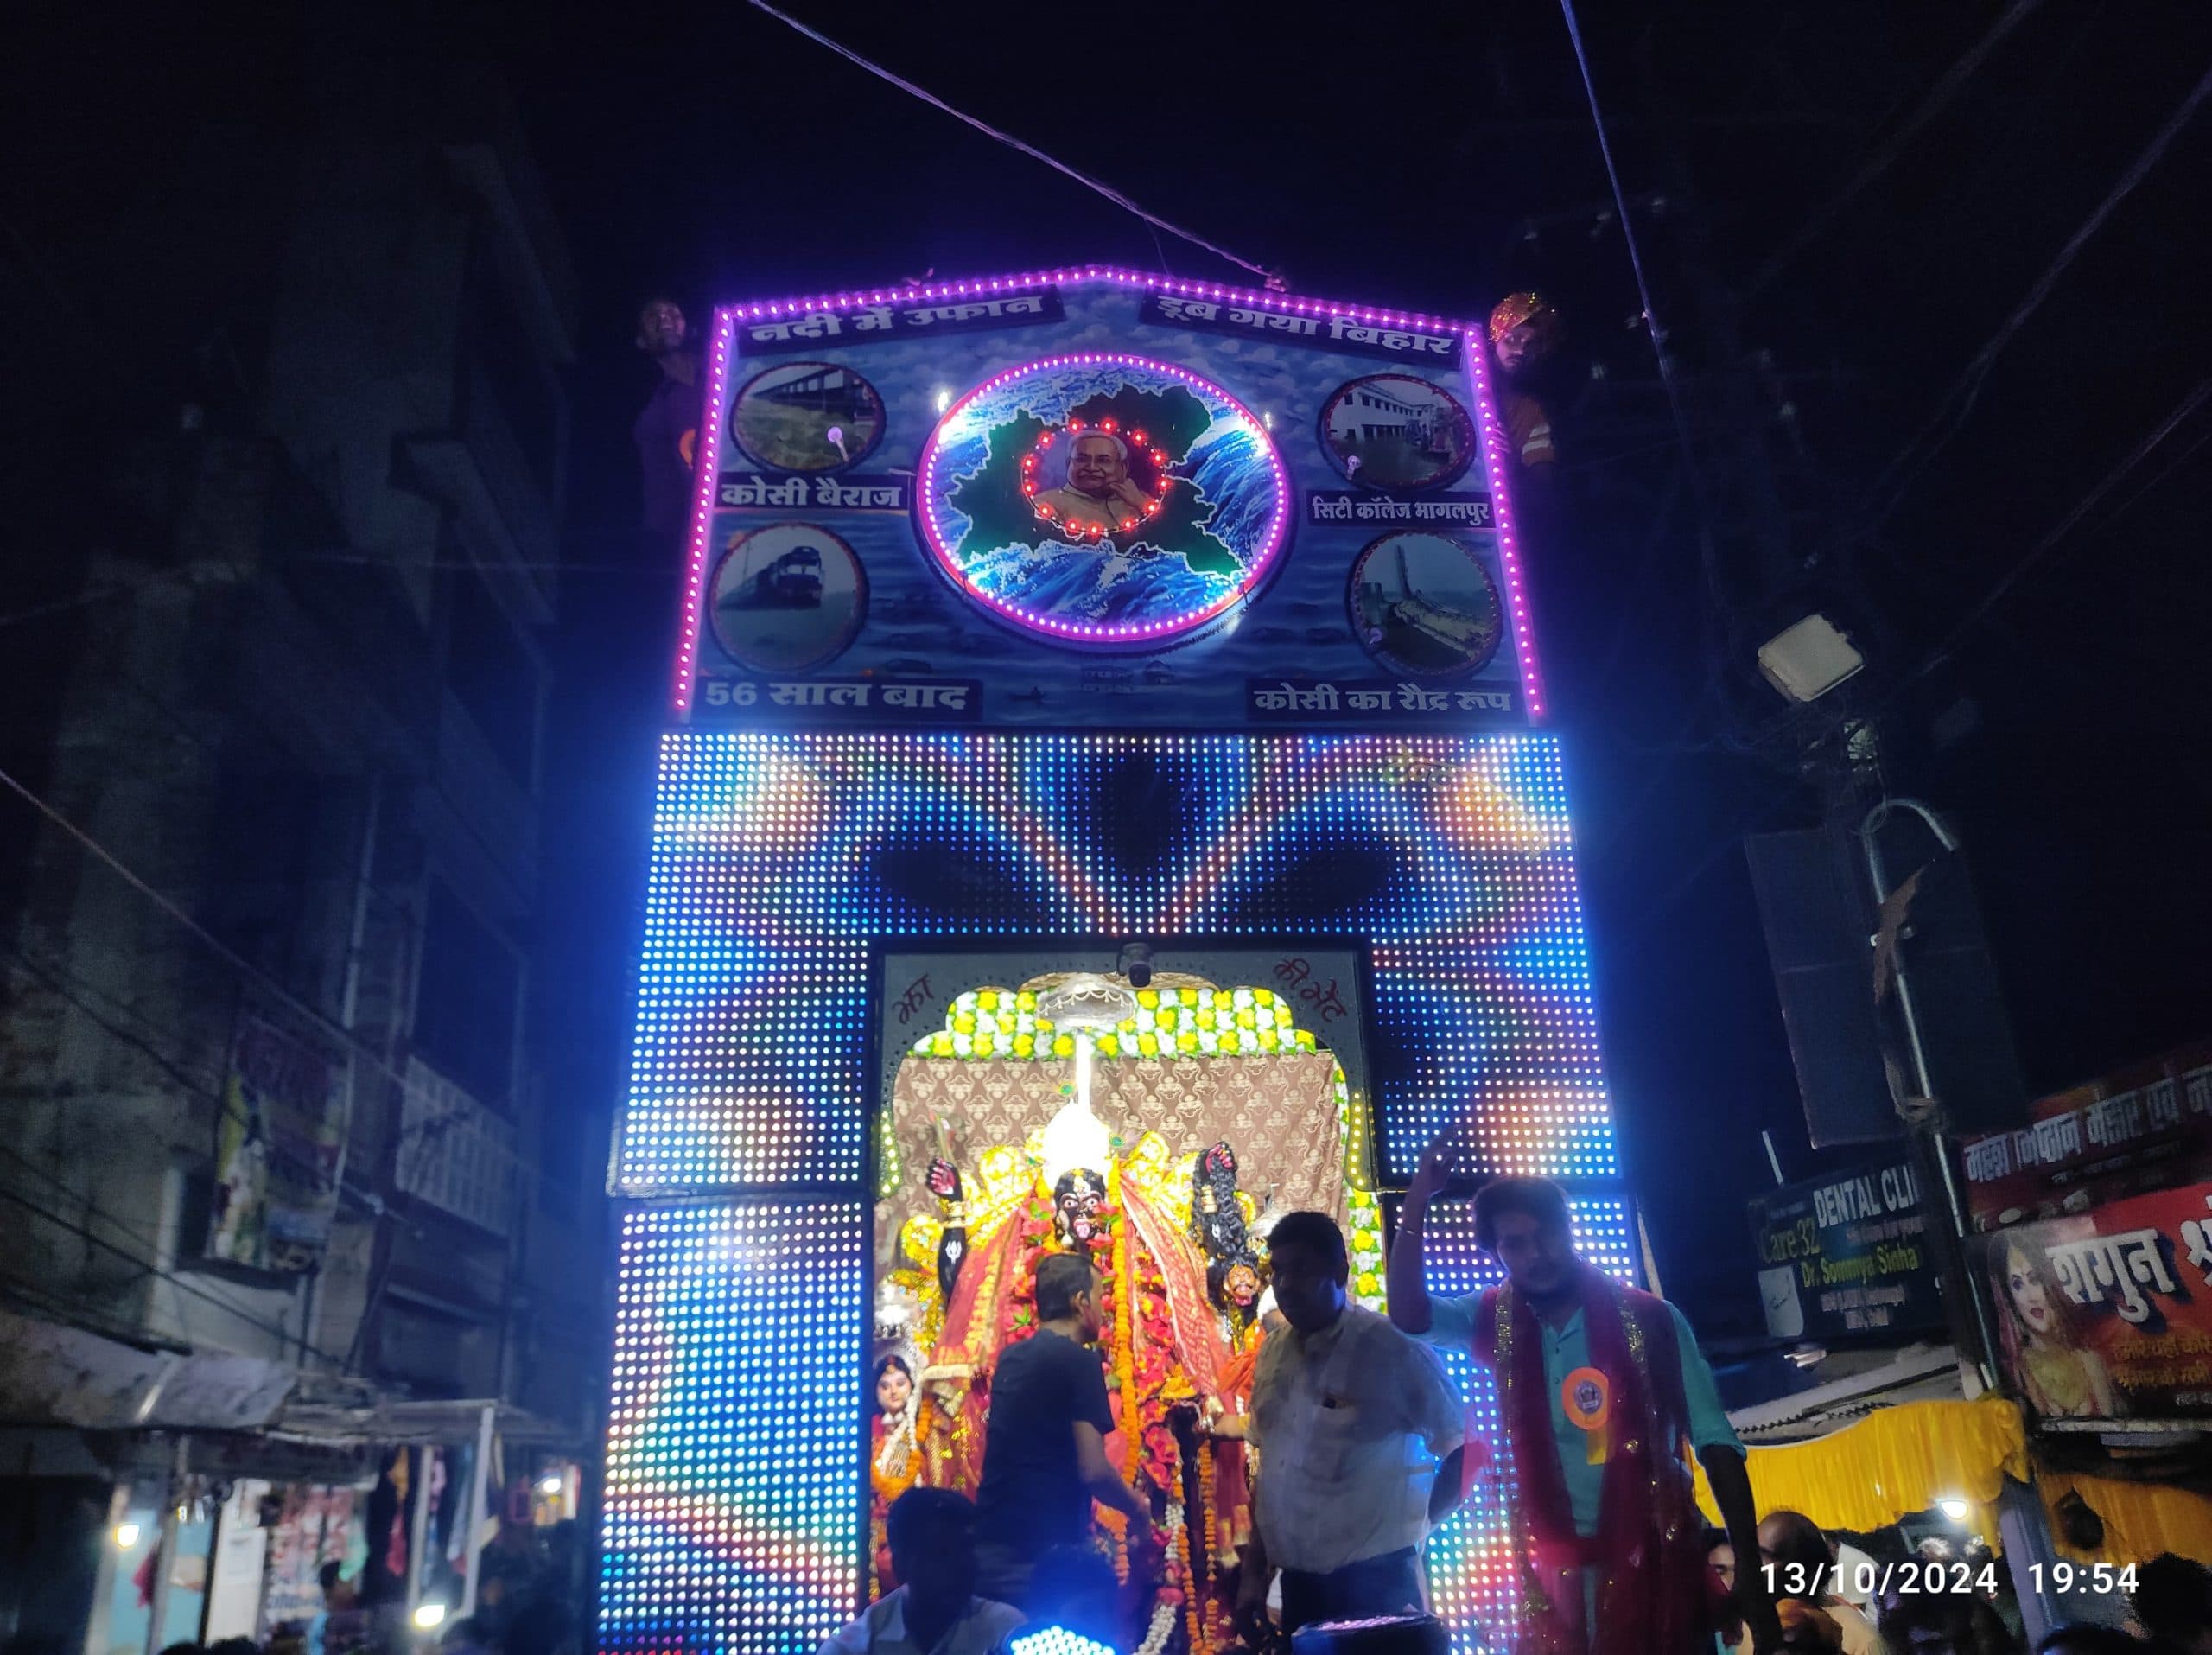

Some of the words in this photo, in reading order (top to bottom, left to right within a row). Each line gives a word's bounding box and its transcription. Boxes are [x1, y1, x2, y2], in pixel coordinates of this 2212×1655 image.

[748, 312, 843, 342] नदी
[851, 305, 898, 334] में
[903, 294, 1044, 327] उफान
[1158, 295, 1222, 323] डूब
[1229, 308, 1320, 338] गया
[1328, 315, 1455, 356] बिहार
[721, 475, 810, 506] कोसी
[815, 476, 903, 506] बैराज
[1313, 496, 1353, 519] सिटी
[1356, 495, 1412, 519] कॉलेज
[1414, 501, 1490, 526] भागलपुर
[705, 682, 757, 706] 56
[769, 682, 872, 708] साल
[880, 684, 970, 710] बाद
[1254, 682, 1340, 710] कोसी
[1345, 691, 1392, 710] का
[1397, 683, 1450, 711] रौद्र
[1455, 691, 1512, 711] रूप
[1273, 958, 1311, 990] की
[1813, 1175, 1882, 1229] DENTAL
[1881, 1163, 1917, 1212] CLI
[1797, 1216, 1821, 1256] 32
[2044, 1228, 2176, 1323] शगुन
